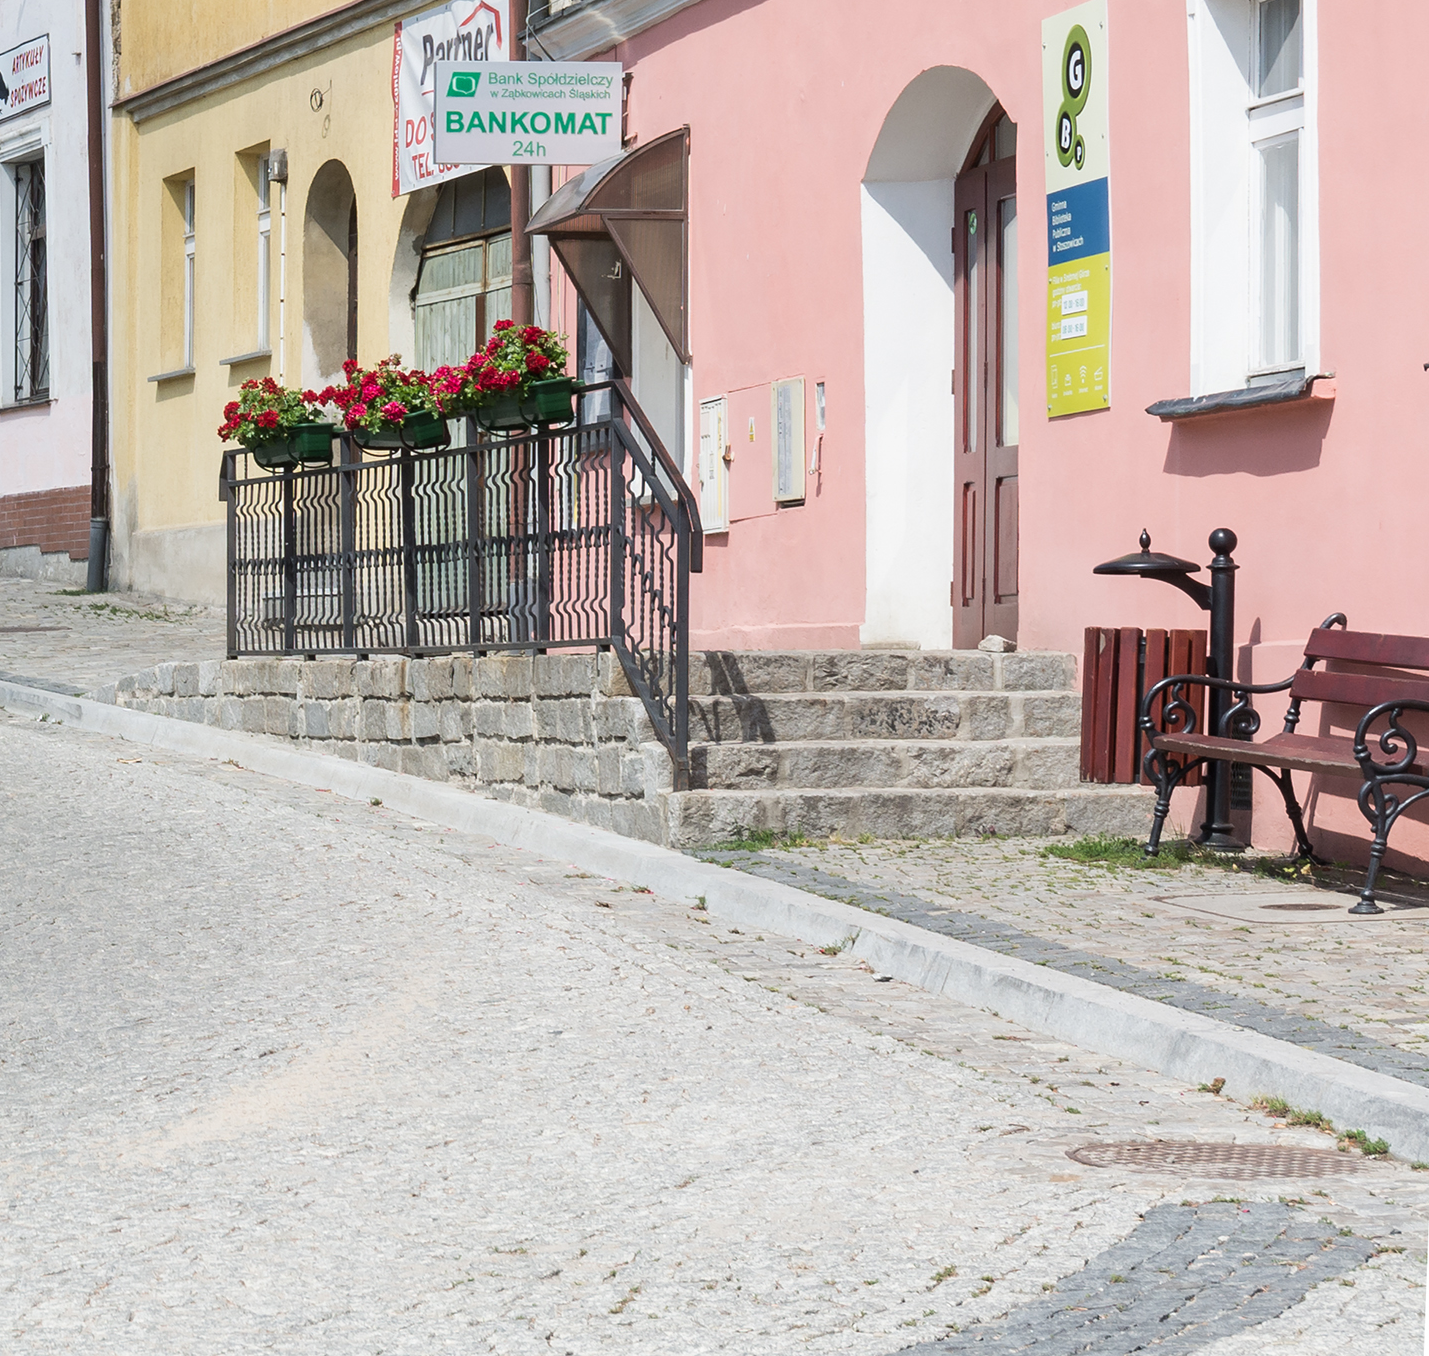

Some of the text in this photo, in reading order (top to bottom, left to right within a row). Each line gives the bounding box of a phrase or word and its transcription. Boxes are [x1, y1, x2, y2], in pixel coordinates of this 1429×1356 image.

[12, 45, 44, 75] ARTYKUŁY
[420, 23, 494, 86] Partner
[488, 72, 613, 88] Bank Spółdzielczy
[1068, 50, 1083, 90] G
[10, 76, 46, 108] SPOŻYWCZE
[490, 88, 611, 101] w Ząbkowicach Śląskich
[405, 116, 427, 148] DO
[446, 110, 613, 135] BANKOMAT
[1060, 118, 1071, 149] B
[512, 140, 546, 157] 24h
[412, 152, 434, 180] TEL.
